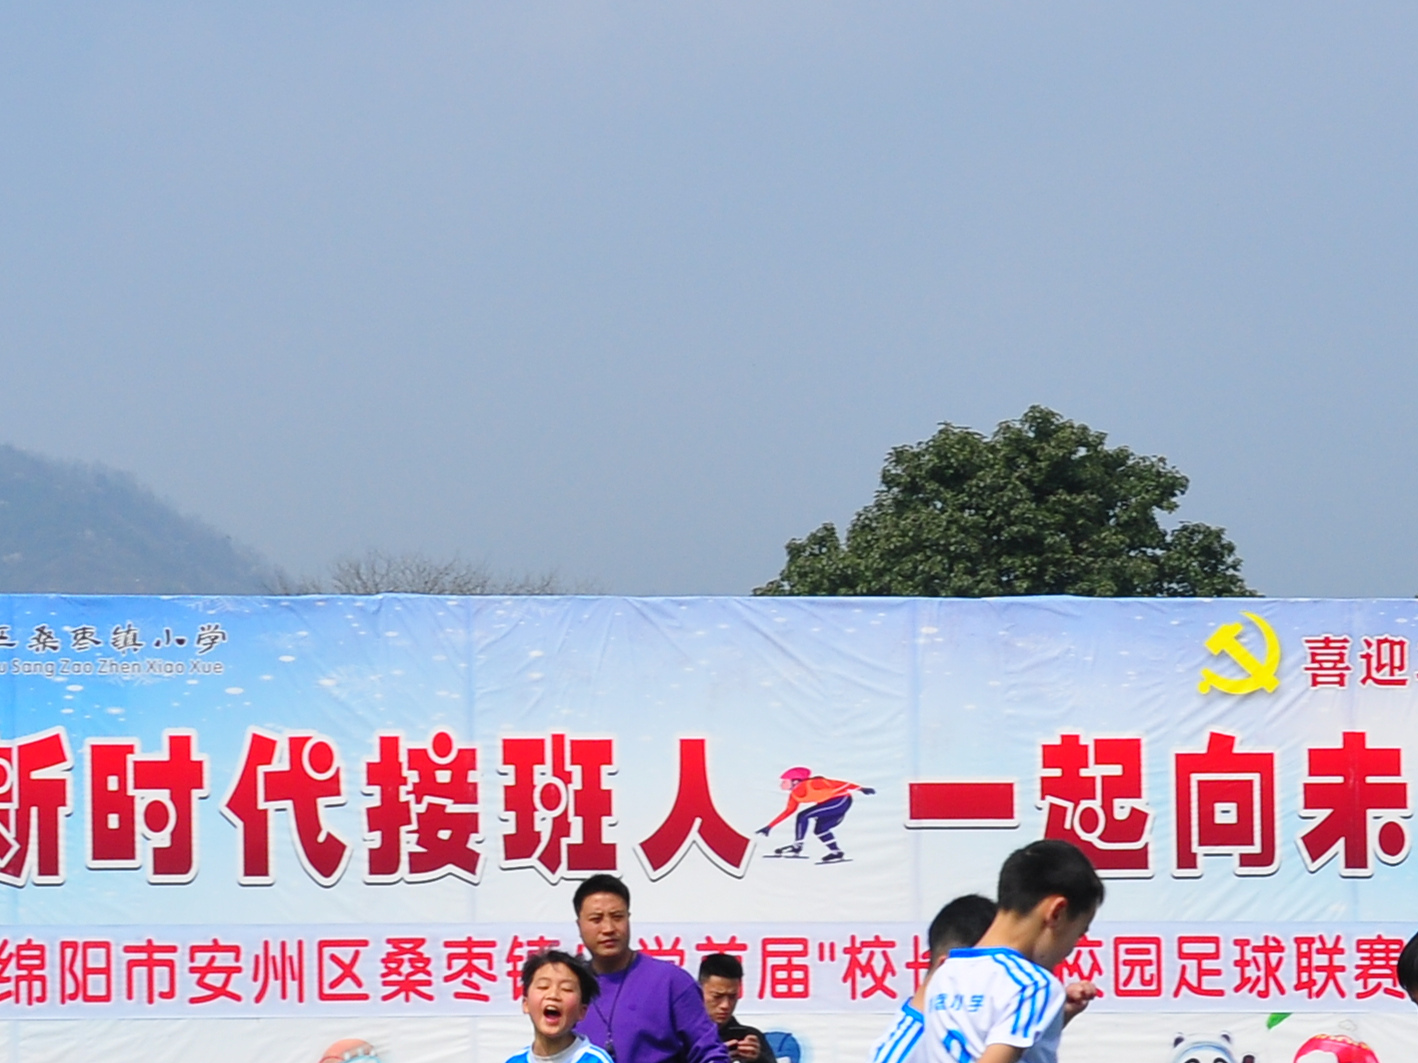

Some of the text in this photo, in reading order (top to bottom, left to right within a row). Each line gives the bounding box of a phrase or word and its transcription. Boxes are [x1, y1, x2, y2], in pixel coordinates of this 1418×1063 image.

[11, 658, 56, 677] Sang
[59, 658, 94, 675] Zao
[97, 658, 142, 675] Zhen
[146, 658, 185, 675] Xiao
[188, 659, 225, 675] Xue
[0, 729, 753, 882] 新时代接班人
